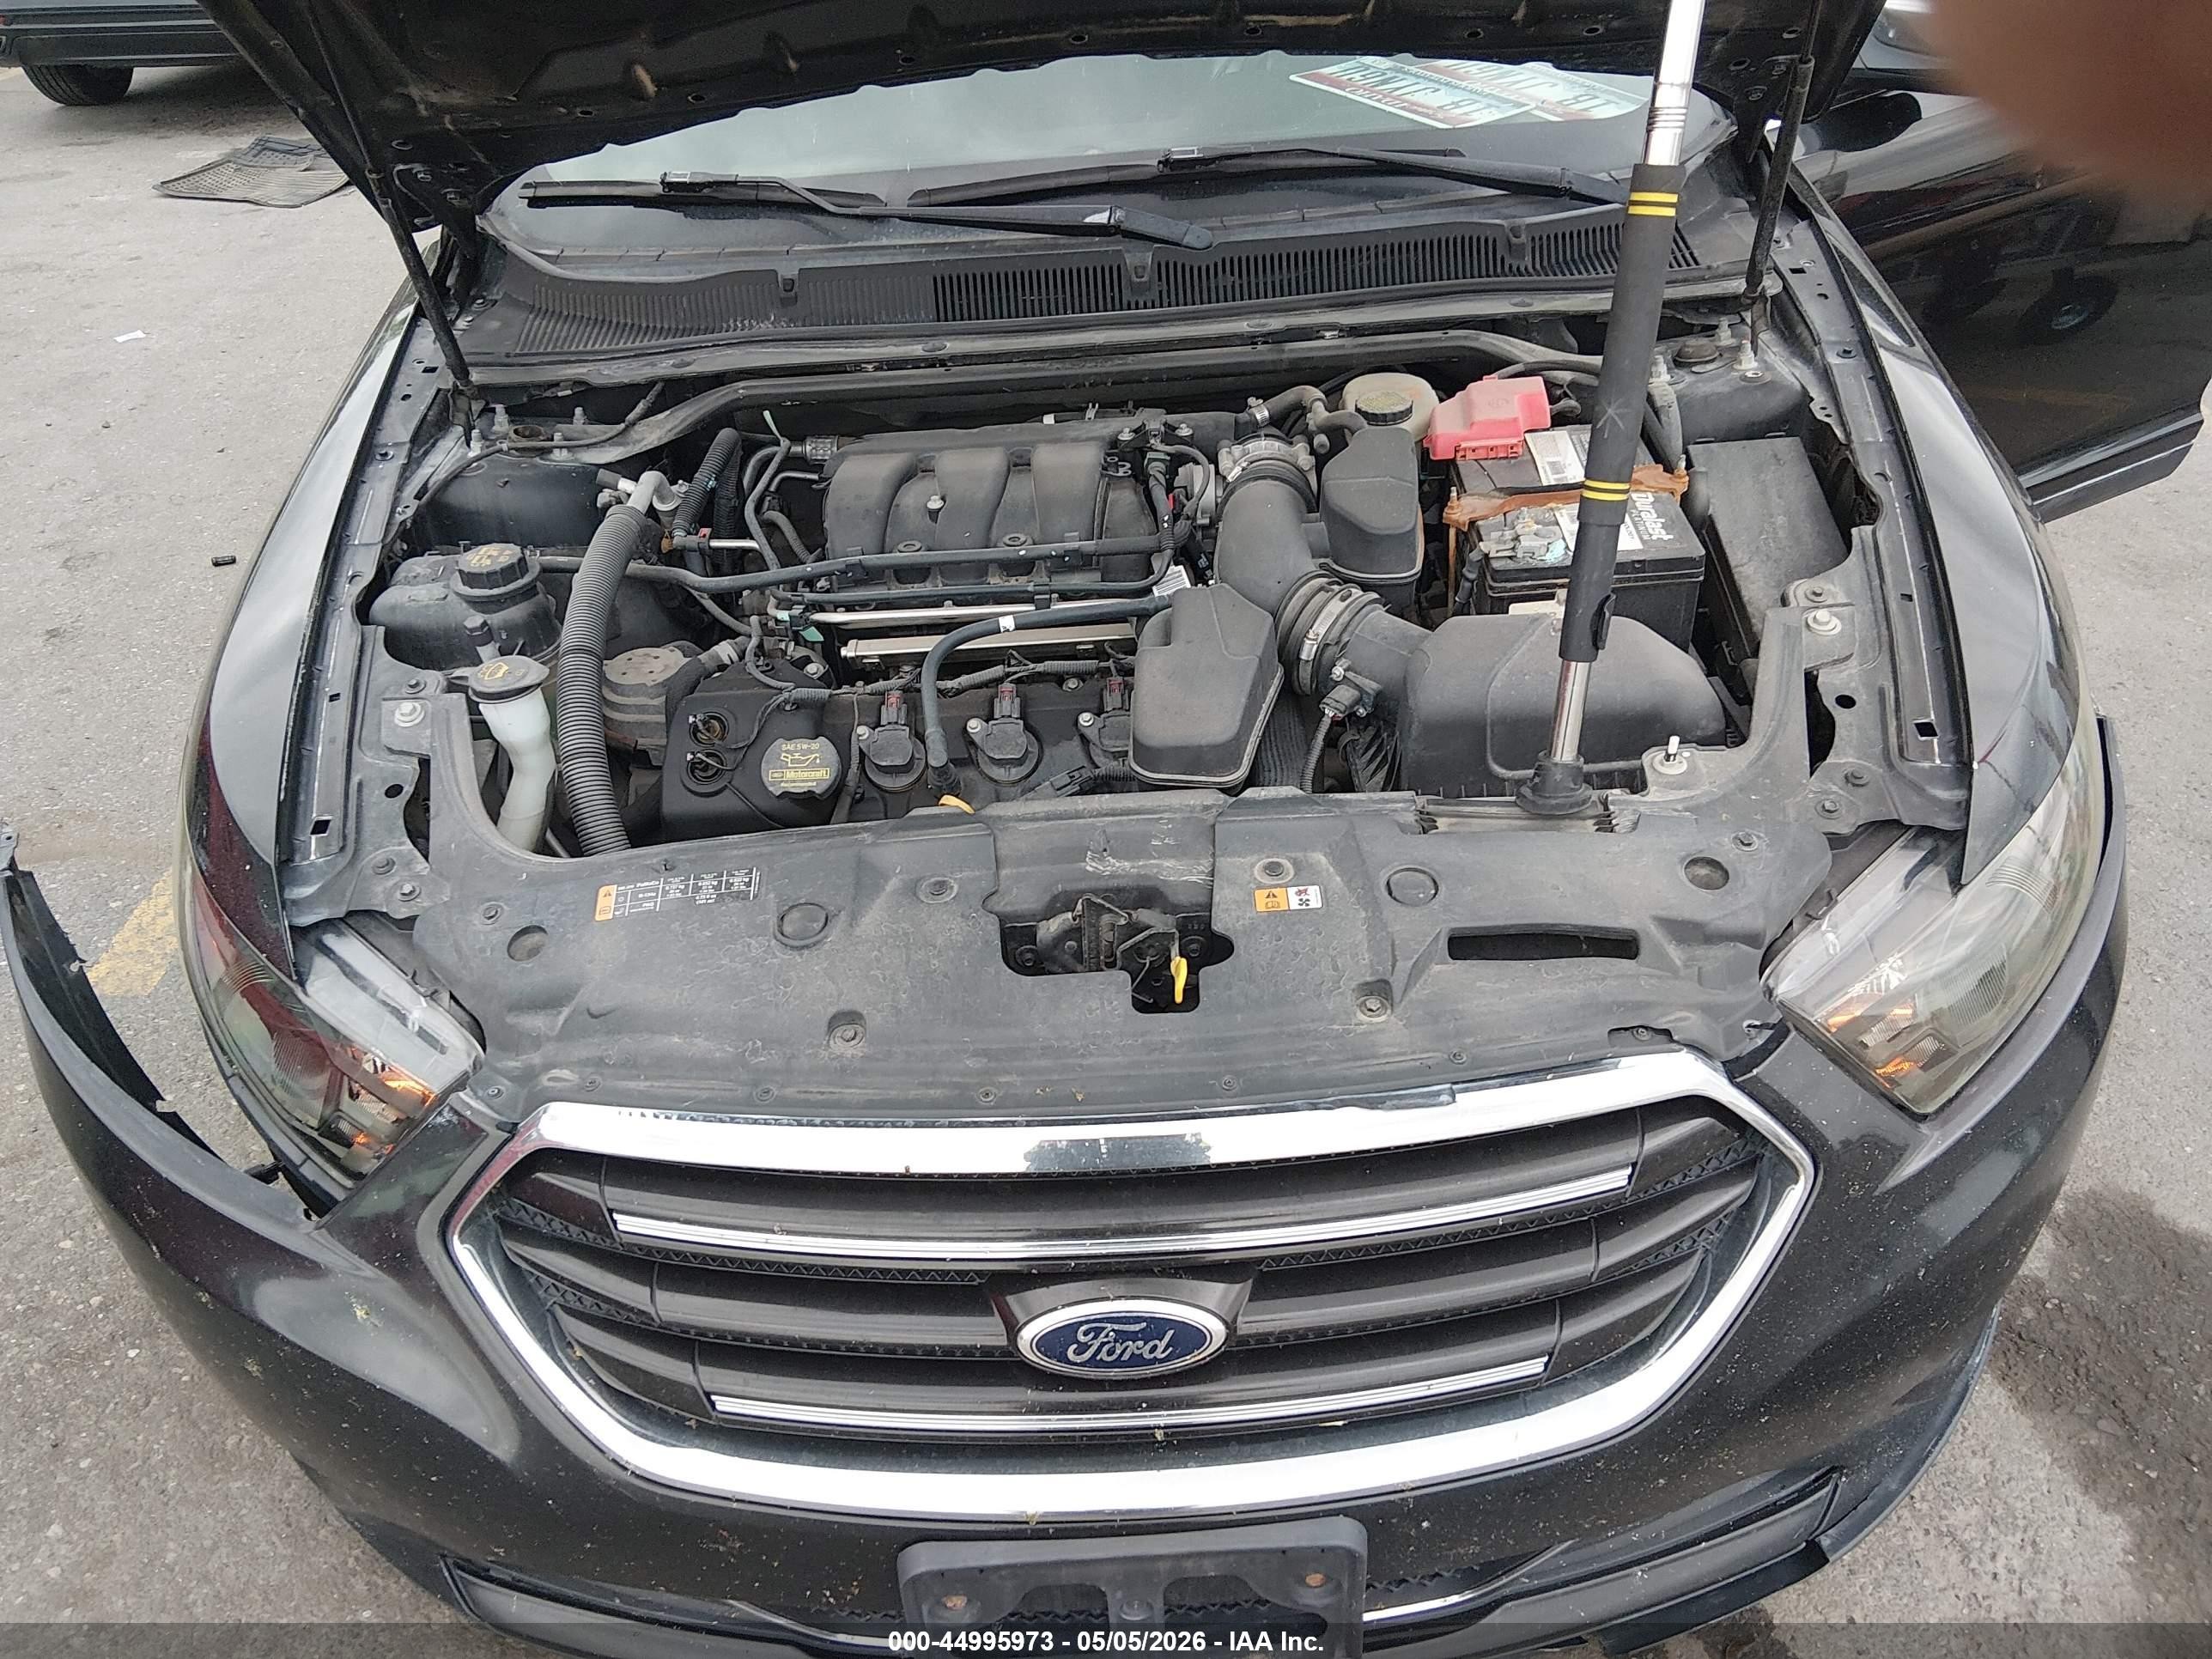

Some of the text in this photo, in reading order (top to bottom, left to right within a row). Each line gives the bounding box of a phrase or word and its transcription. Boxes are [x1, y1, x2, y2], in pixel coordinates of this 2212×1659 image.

[1631, 491, 1674, 541] Duralast
[1632, 509, 1652, 541] PLATINUM
[796, 742, 820, 750] 5W-20
[786, 769, 829, 779] Motorcraft
[1066, 1322, 1175, 1364] Ford
